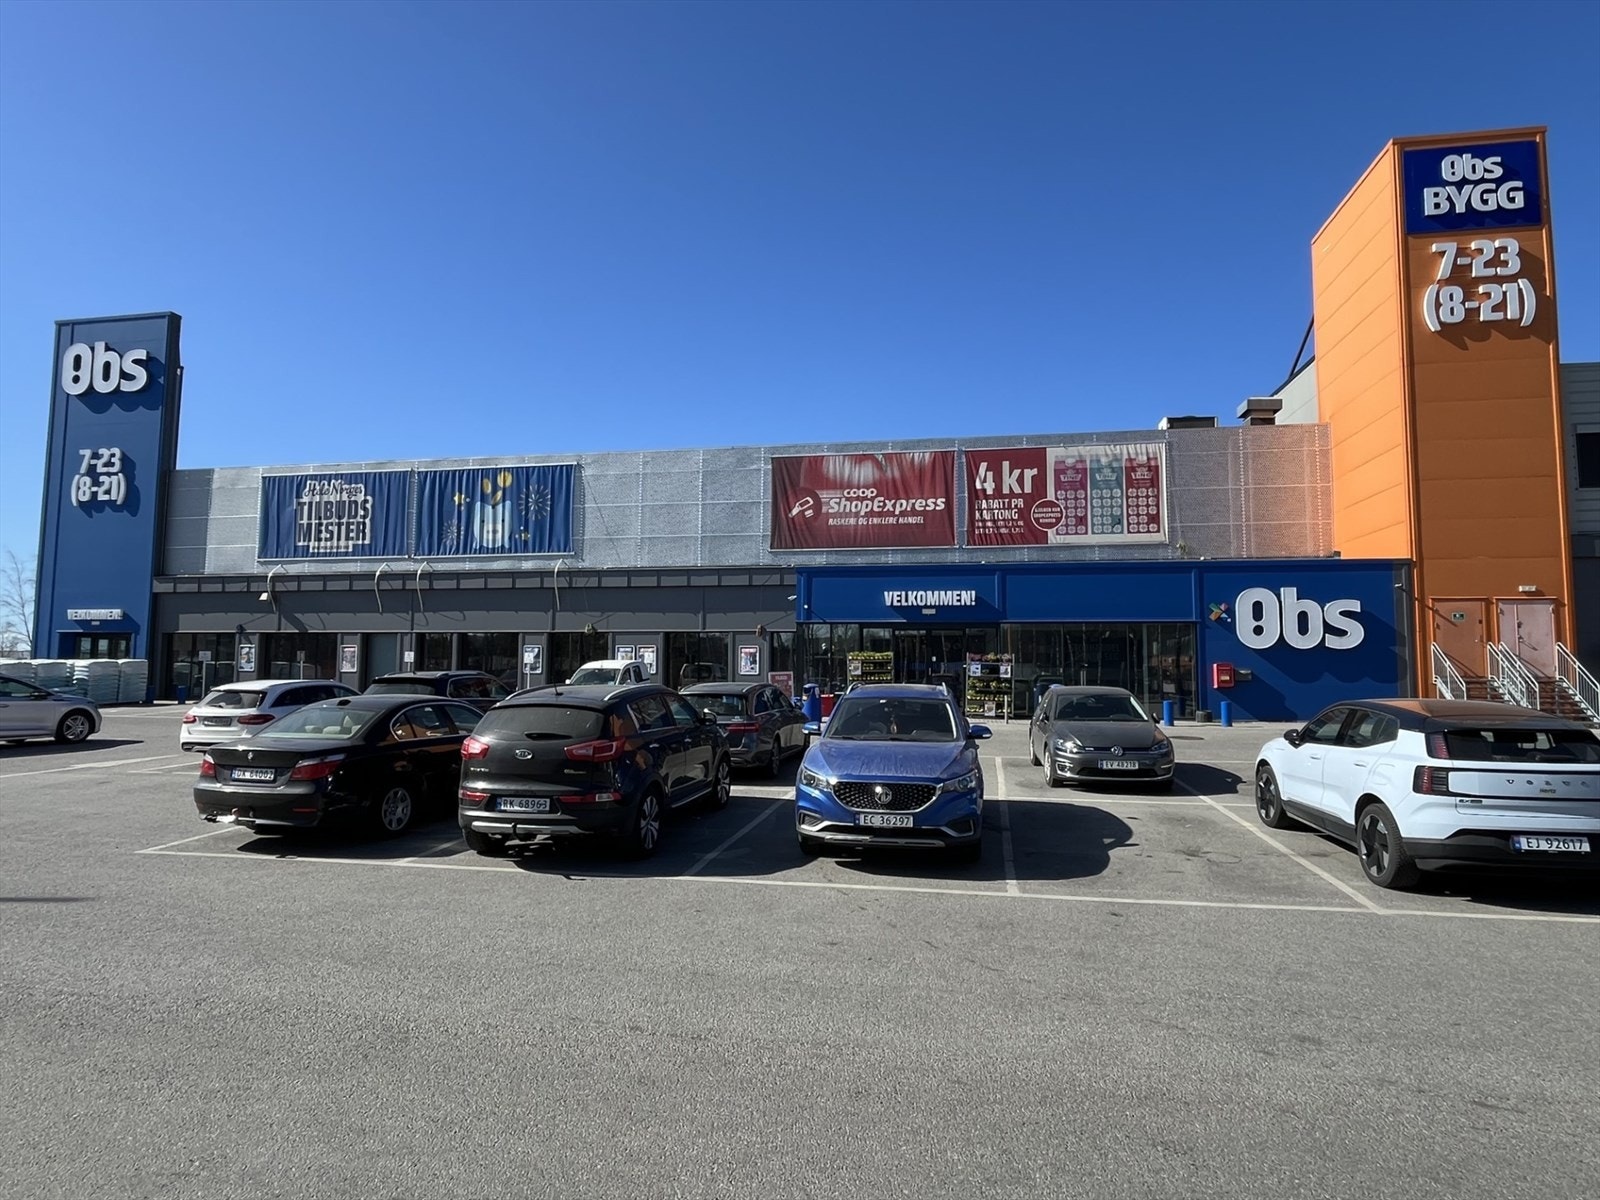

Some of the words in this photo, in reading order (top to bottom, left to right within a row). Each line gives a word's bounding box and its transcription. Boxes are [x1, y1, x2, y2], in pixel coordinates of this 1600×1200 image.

[1441, 153, 1504, 182] Obs
[1423, 181, 1525, 216] BYGG
[1431, 237, 1521, 280] 7-23
[1423, 278, 1537, 332] (8-21)
[61, 341, 148, 396] Obs
[78, 447, 122, 474] 7-23
[975, 461, 995, 495] 4
[1002, 460, 1038, 494] kr
[71, 472, 127, 507] (8-21)
[303, 480, 330, 497] Hele
[330, 479, 363, 499] Norges
[843, 487, 877, 499] coop
[297, 498, 370, 521] TILBUDS
[828, 496, 946, 515] ShopExpress
[975, 499, 1009, 509] RABATT
[1011, 498, 1024, 509] PR
[975, 508, 1018, 520] KARTONG
[828, 517, 857, 526] RASKERE
[858, 517, 868, 525] OG
[868, 516, 898, 525] ENKLERE
[898, 515, 924, 524] HANDEL
[297, 521, 367, 543] MESTER
[884, 590, 976, 606] VELKOMMEN!
[1235, 587, 1365, 649] Obs
[502, 798, 515, 809] RK
[518, 799, 547, 810] 68963
[863, 814, 875, 825] EC
[880, 815, 910, 826] 36297
[1526, 837, 1540, 849] EJ
[1546, 837, 1584, 850] 92617
